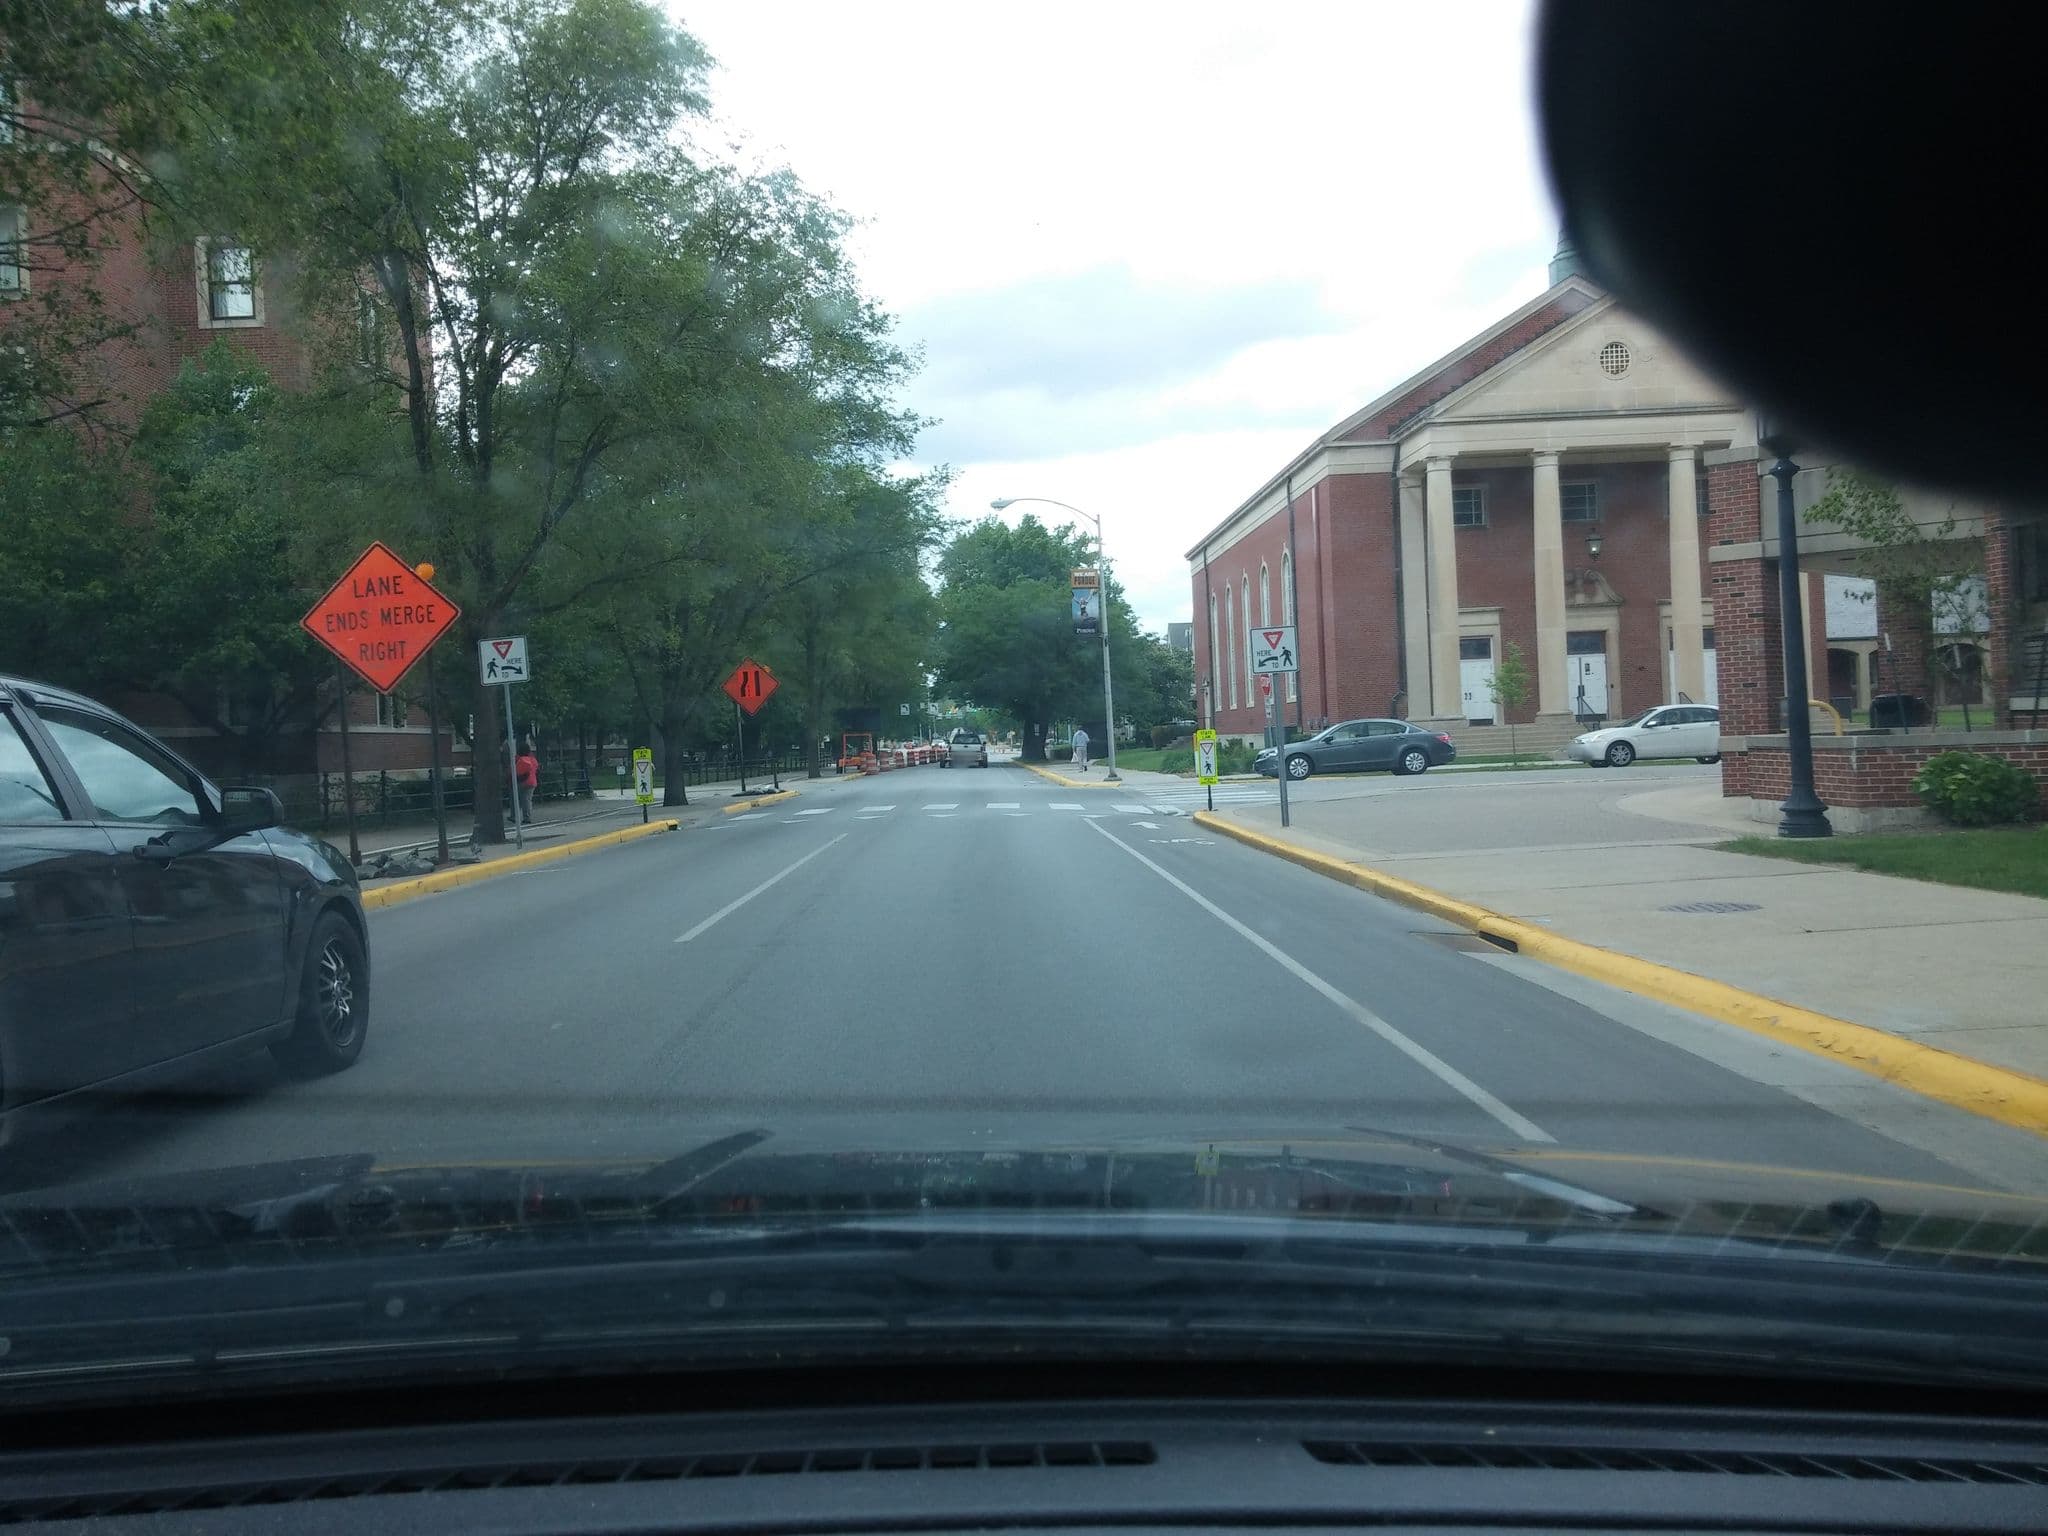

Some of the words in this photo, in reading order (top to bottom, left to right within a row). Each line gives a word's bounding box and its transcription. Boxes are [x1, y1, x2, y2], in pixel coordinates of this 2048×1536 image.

[1073, 576, 1096, 585] PURDUE
[353, 575, 404, 598] LANE
[326, 610, 369, 633] ENDS
[380, 604, 435, 625] MERGE
[359, 640, 407, 662] RIGHT
[1256, 649, 1272, 657] HERE
[506, 657, 524, 665] HERE
[502, 671, 510, 679] TO
